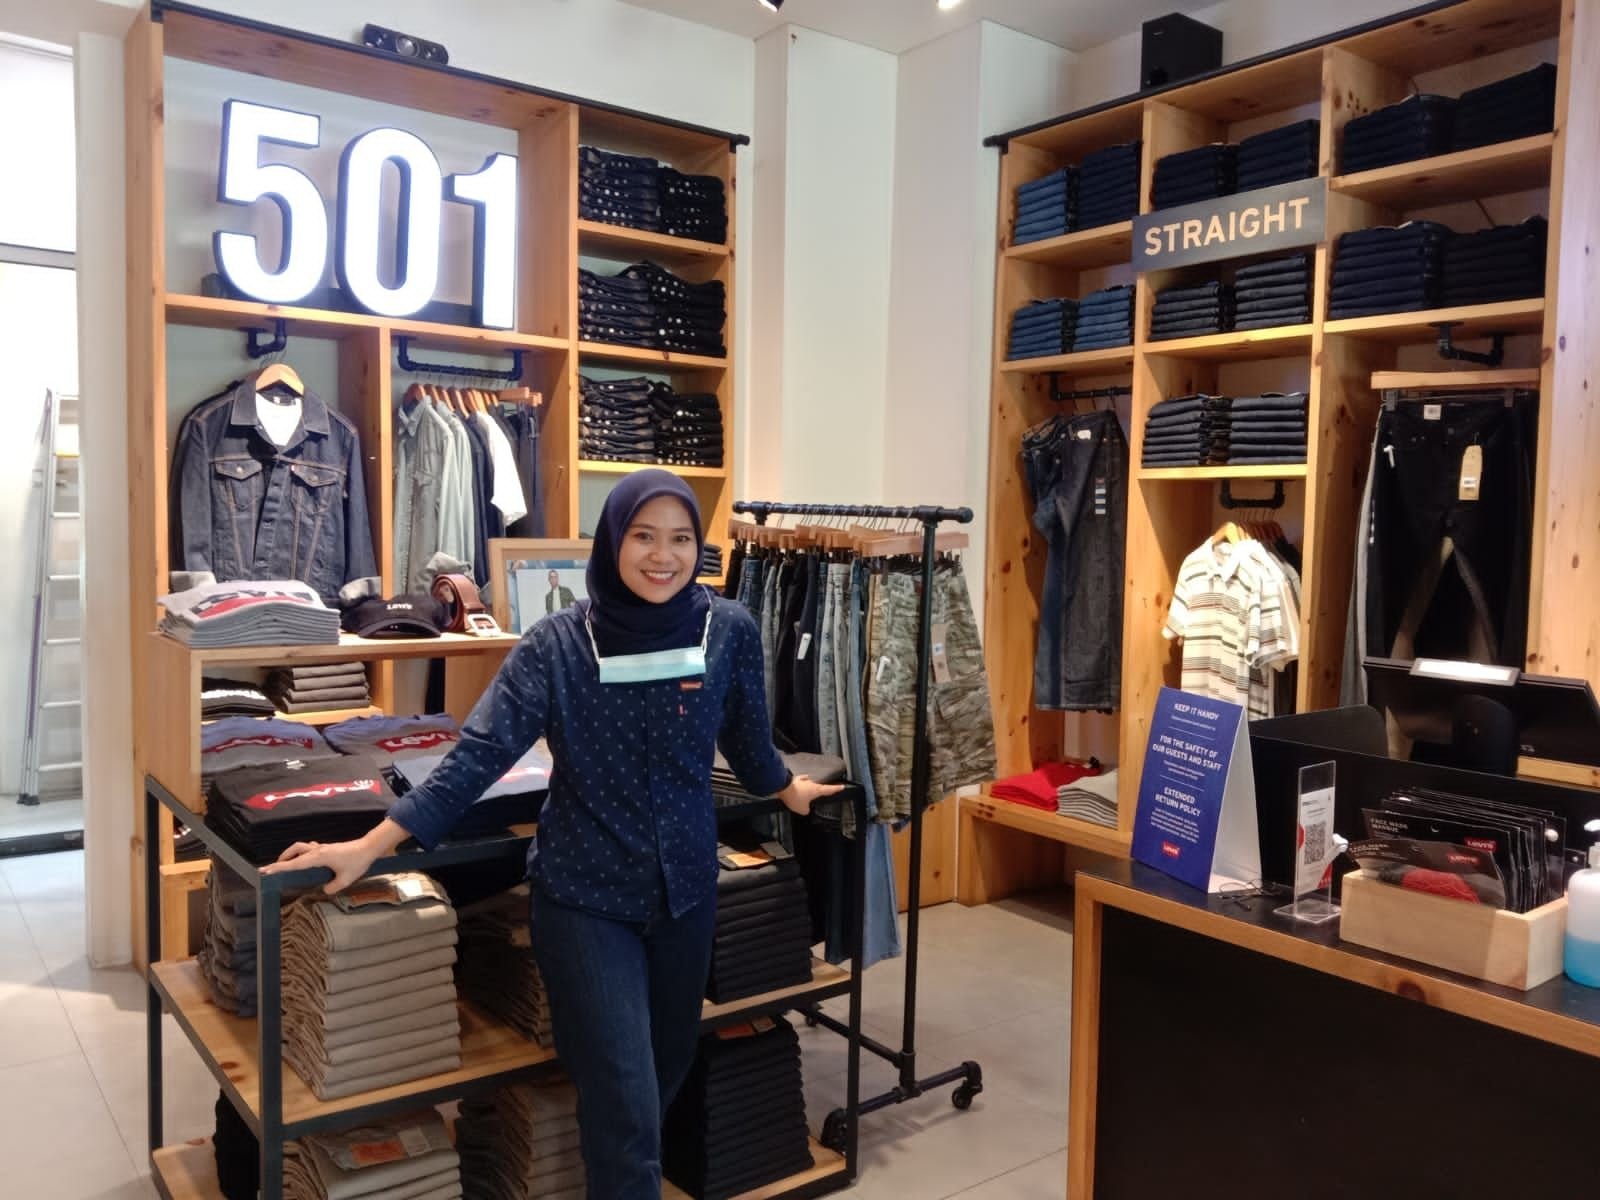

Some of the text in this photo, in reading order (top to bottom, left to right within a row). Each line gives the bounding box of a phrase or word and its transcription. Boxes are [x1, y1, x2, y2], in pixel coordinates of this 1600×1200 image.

[213, 98, 518, 330] 501
[1144, 197, 1310, 256] STRAIGHT
[1174, 703, 1220, 721] KEEP IT HANDY
[1152, 743, 1165, 753] OUR
[1165, 747, 1188, 761] GUESTS
[1188, 754, 1202, 765] AND
[1202, 759, 1223, 772] STAFF
[1159, 735, 1219, 760] FOR THE SAFETY OF
[1155, 793, 1202, 817] RETURN POLICY
[1164, 786, 1196, 805] EXTENDED
